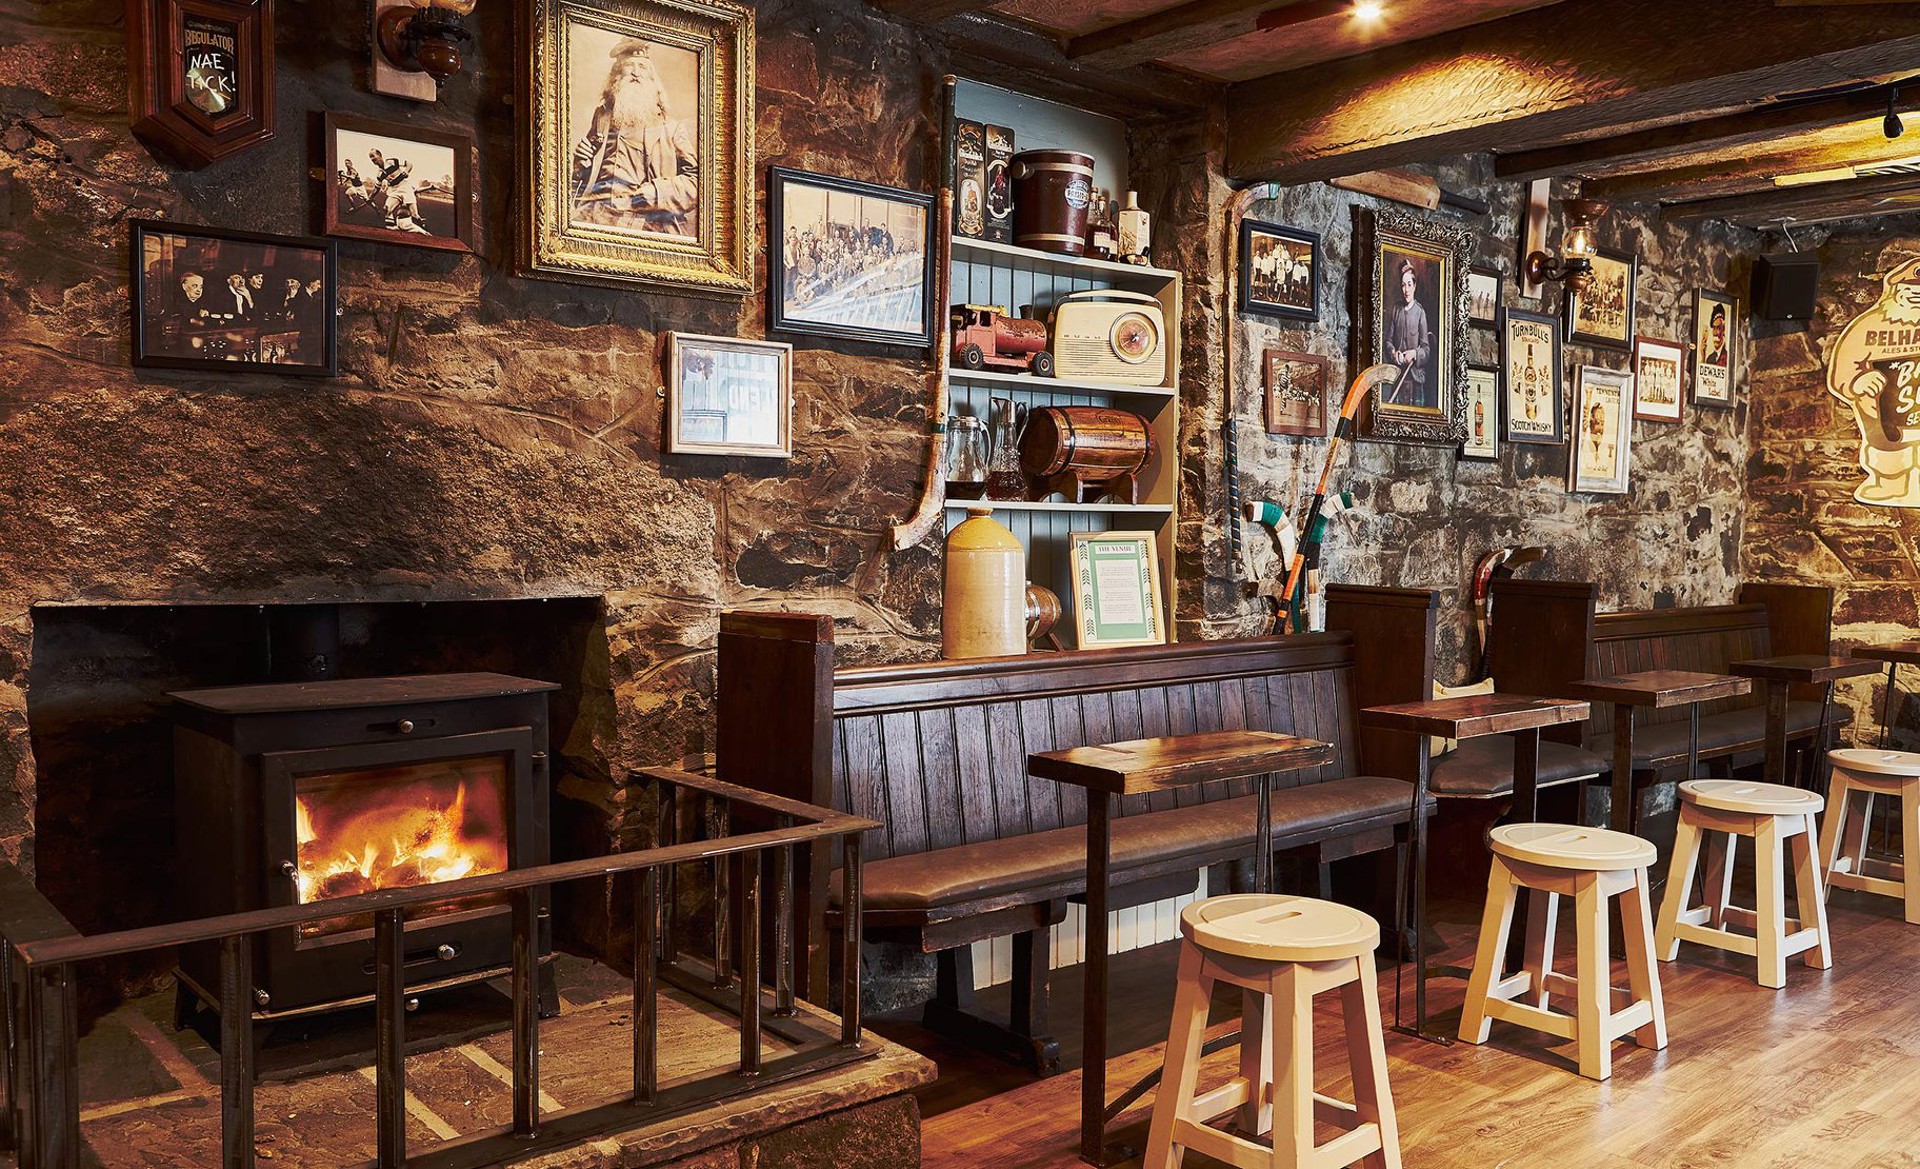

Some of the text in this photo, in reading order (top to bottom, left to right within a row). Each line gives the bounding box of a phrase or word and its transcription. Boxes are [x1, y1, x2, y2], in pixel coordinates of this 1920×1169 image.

[185, 29, 234, 55] REGULATOR
[191, 53, 225, 70] NAE
[1881, 346, 1900, 354] ALES
[1909, 345, 1920, 353] ST
